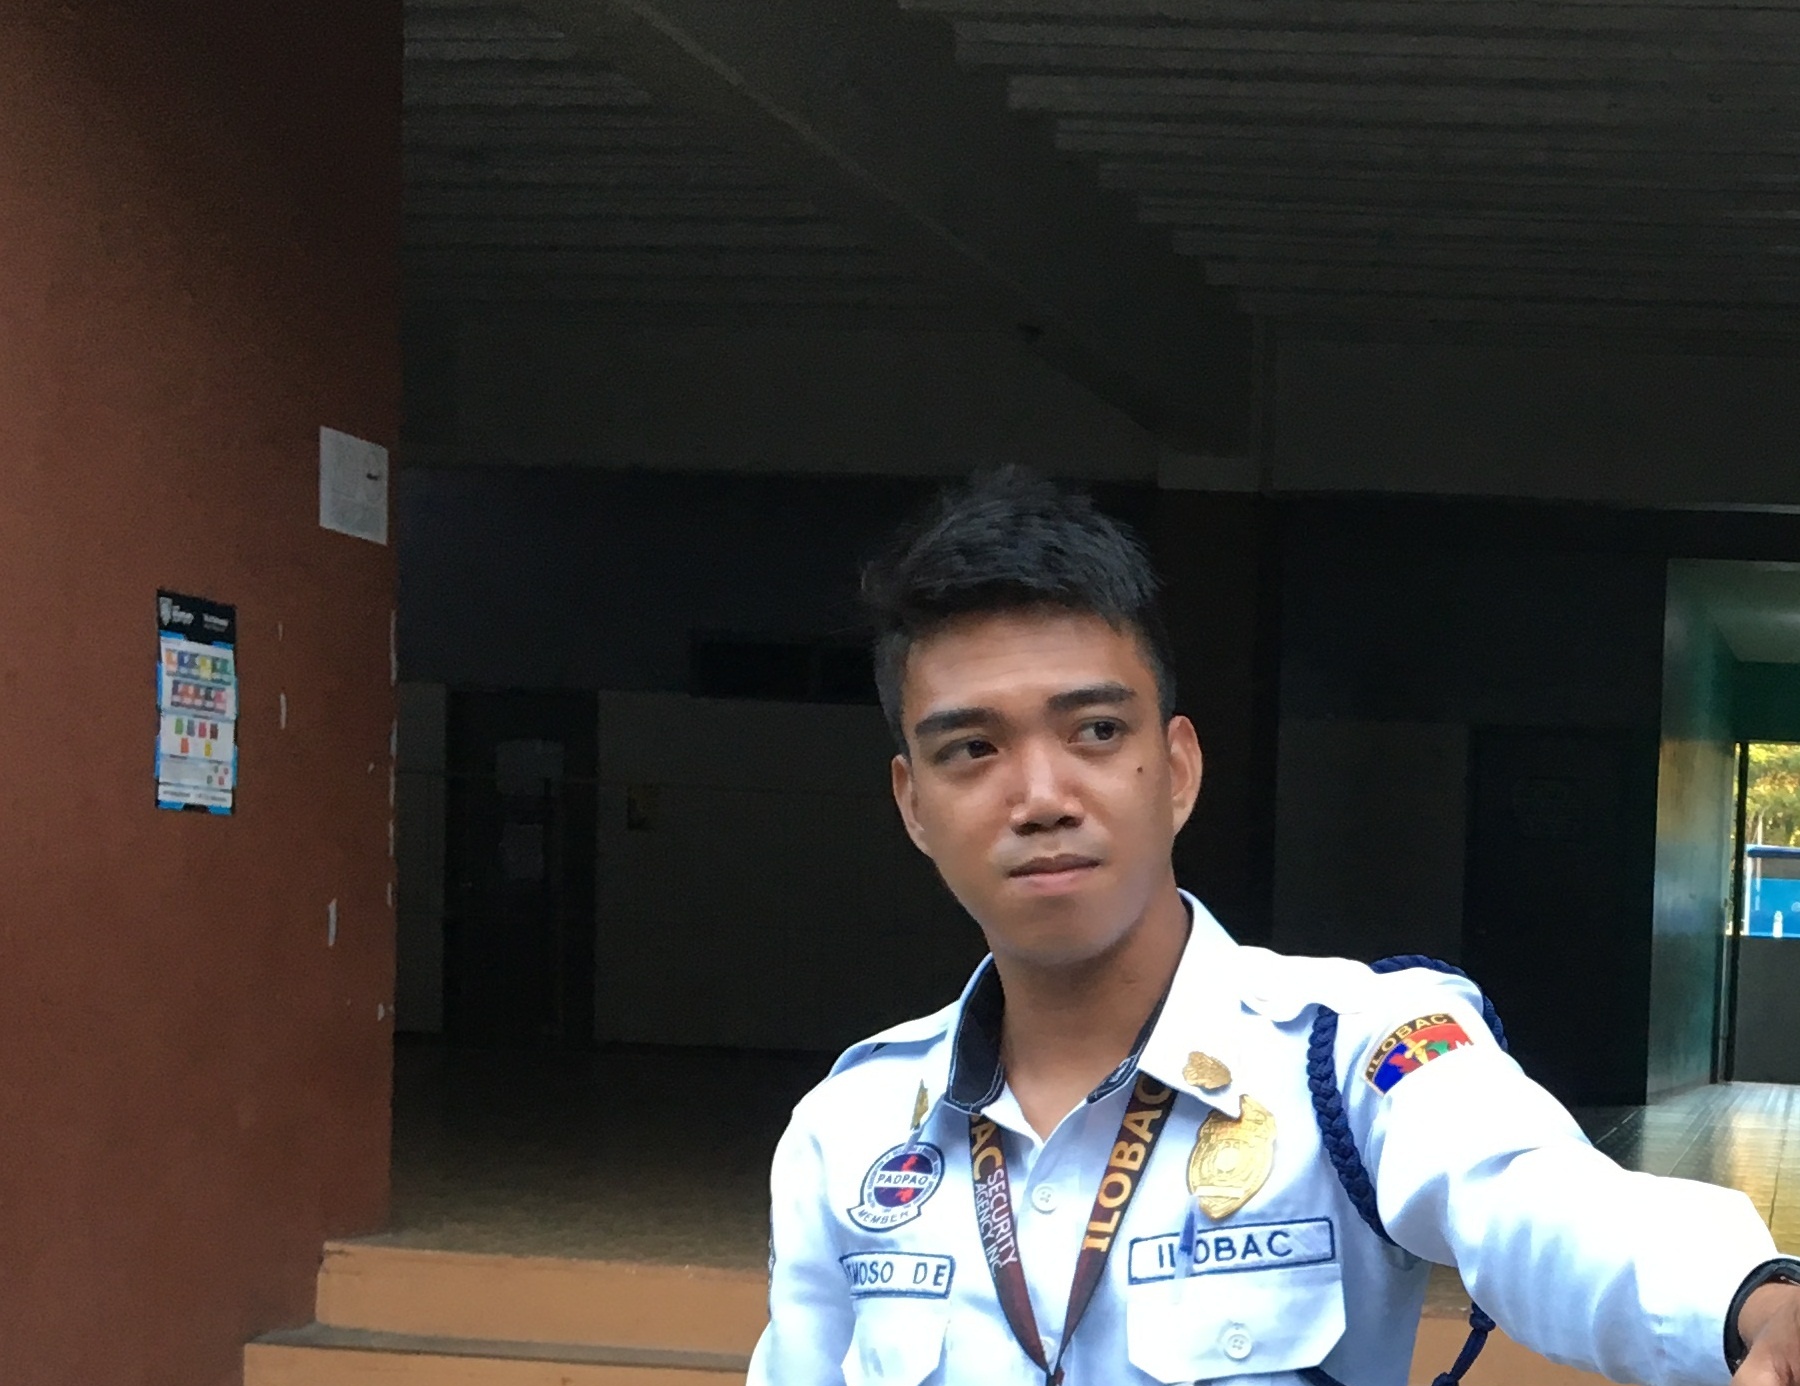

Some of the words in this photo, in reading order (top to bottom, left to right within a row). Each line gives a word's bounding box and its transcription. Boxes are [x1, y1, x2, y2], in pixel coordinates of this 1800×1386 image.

[1367, 1013, 1448, 1074] ILOBAC
[876, 1172, 929, 1187] PADPAO
[1082, 1069, 1174, 1253] ILOBAC
[857, 1208, 910, 1225] MEMBER
[974, 1182, 995, 1241] AGENCY
[987, 1168, 1018, 1269] SECURITY
